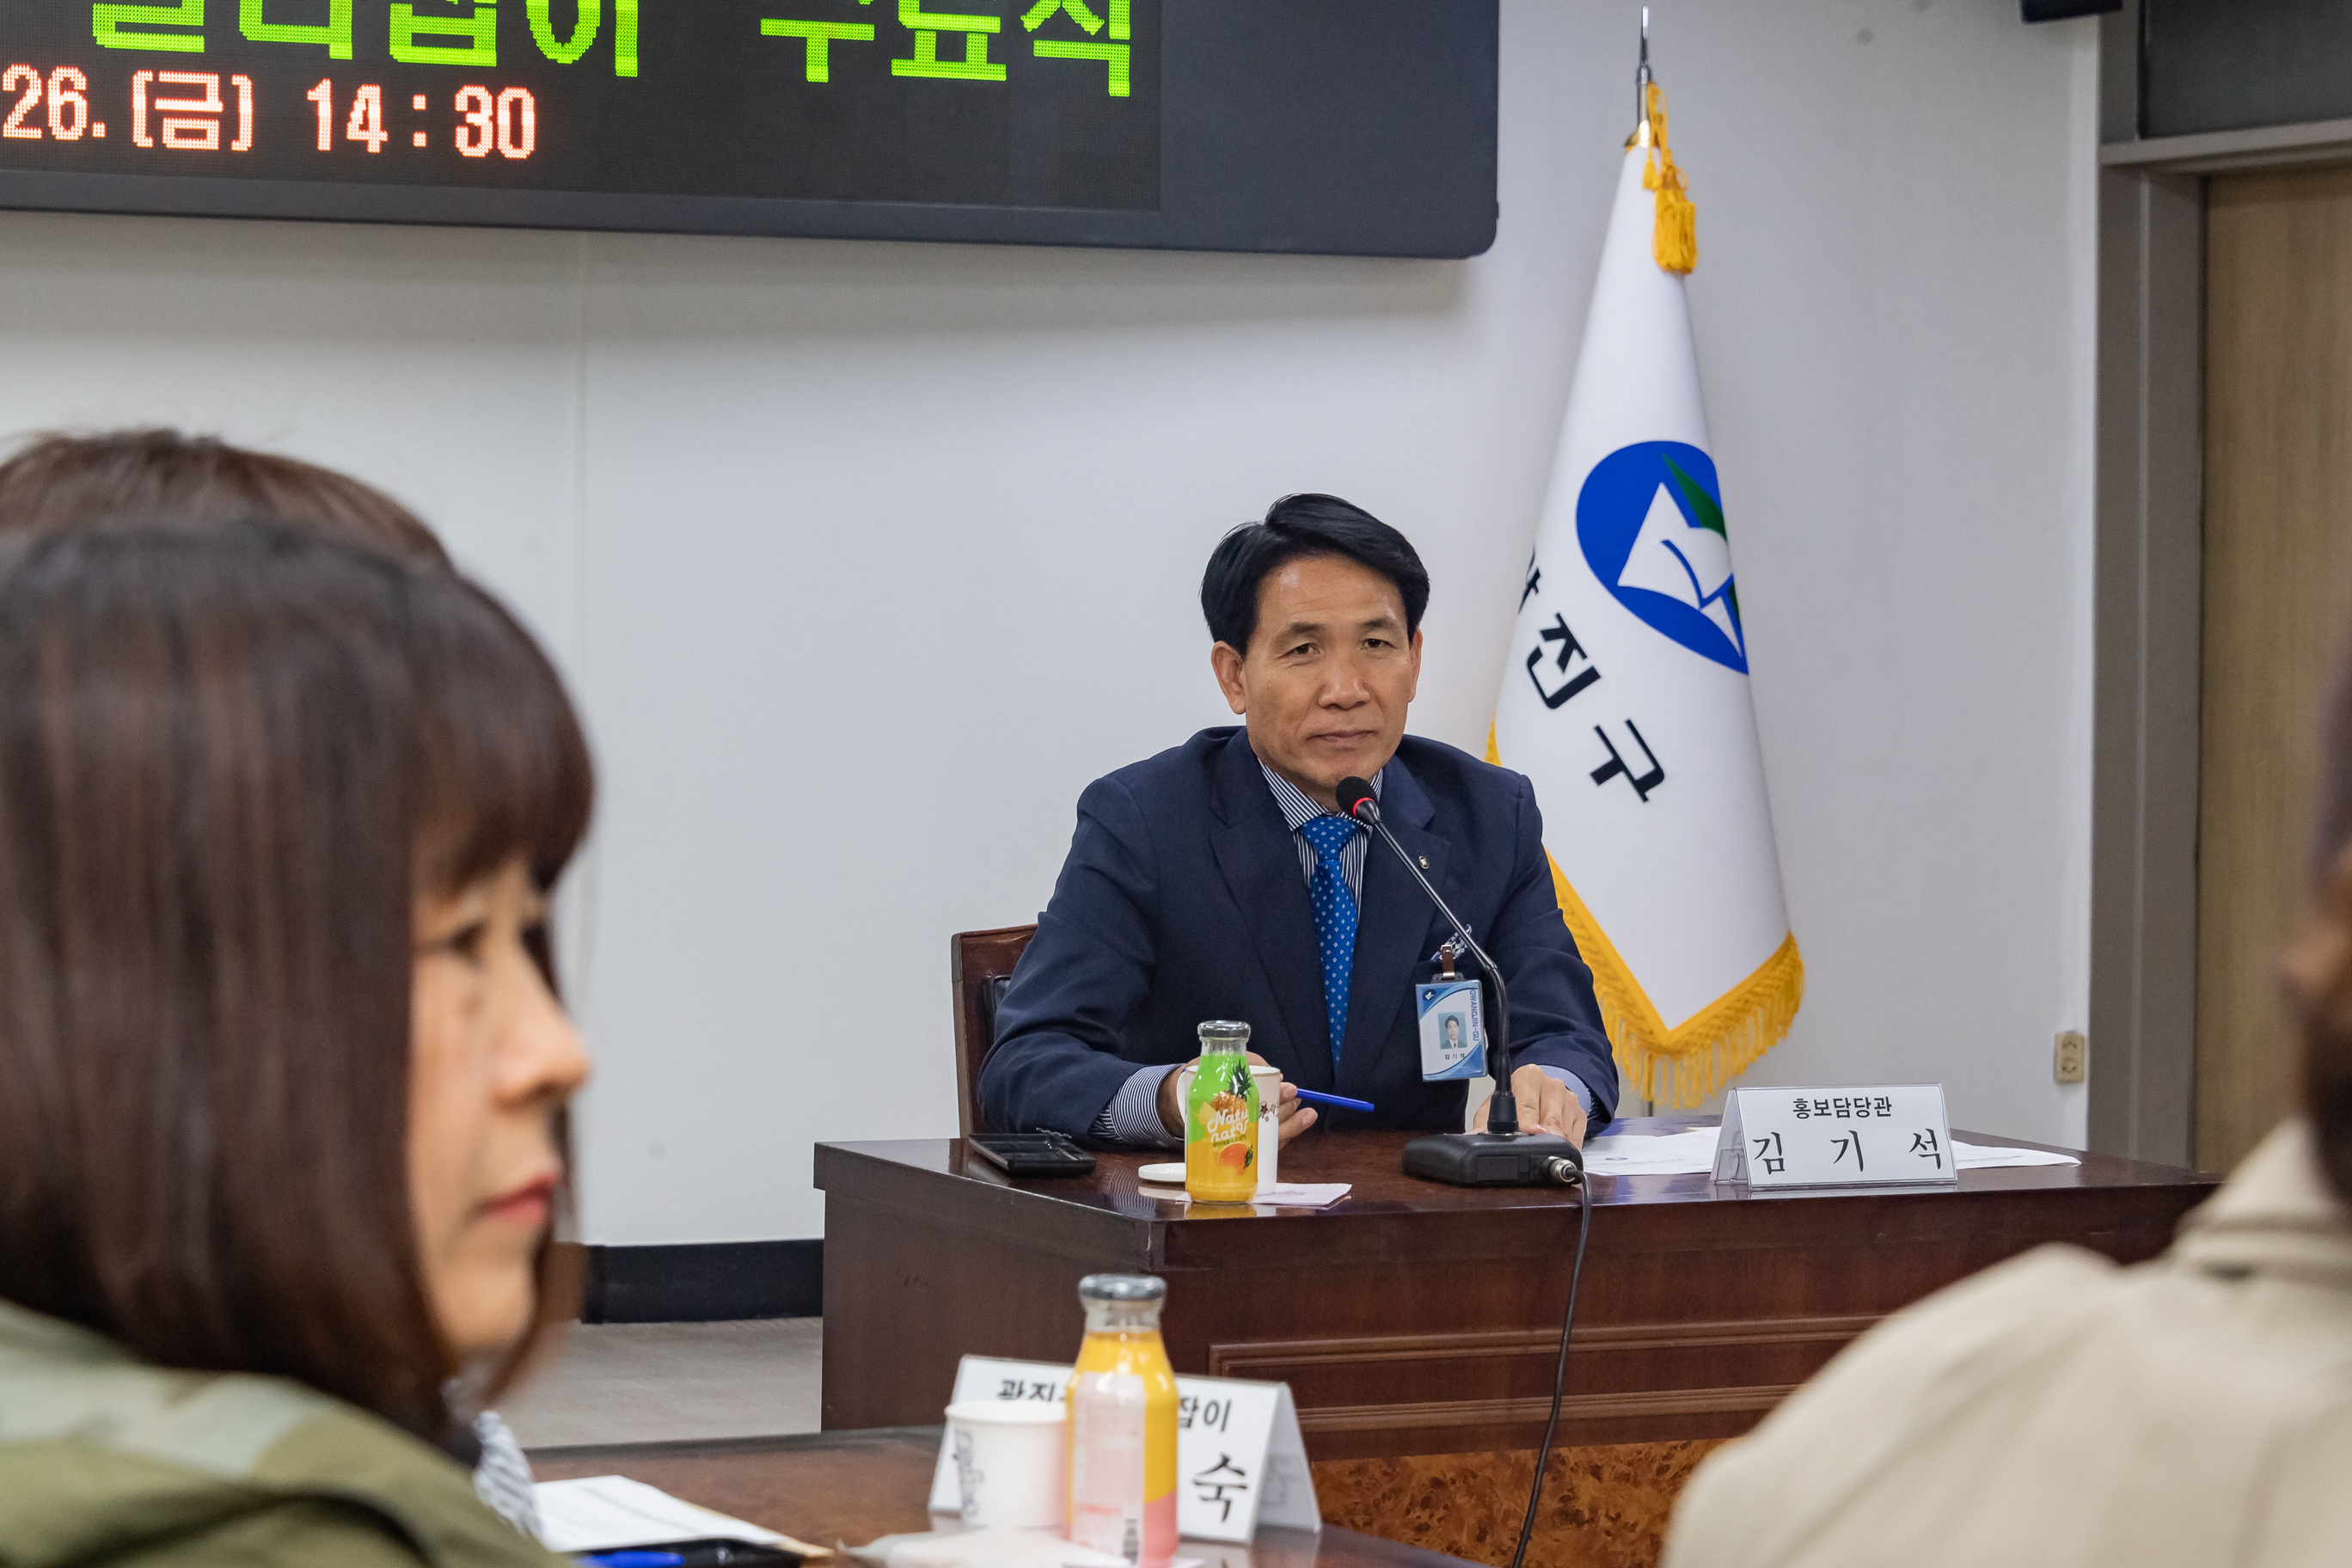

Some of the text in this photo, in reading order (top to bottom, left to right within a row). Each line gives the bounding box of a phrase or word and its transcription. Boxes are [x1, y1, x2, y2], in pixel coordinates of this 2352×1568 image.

[1518, 545, 1665, 803] 진구
[1469, 989, 1480, 1042] GWANGJIN-GU
[1792, 1096, 1892, 1119] 홍보담당관
[1752, 1128, 1941, 1175] 김 기 석
[1191, 1453, 1248, 1522] 숙
